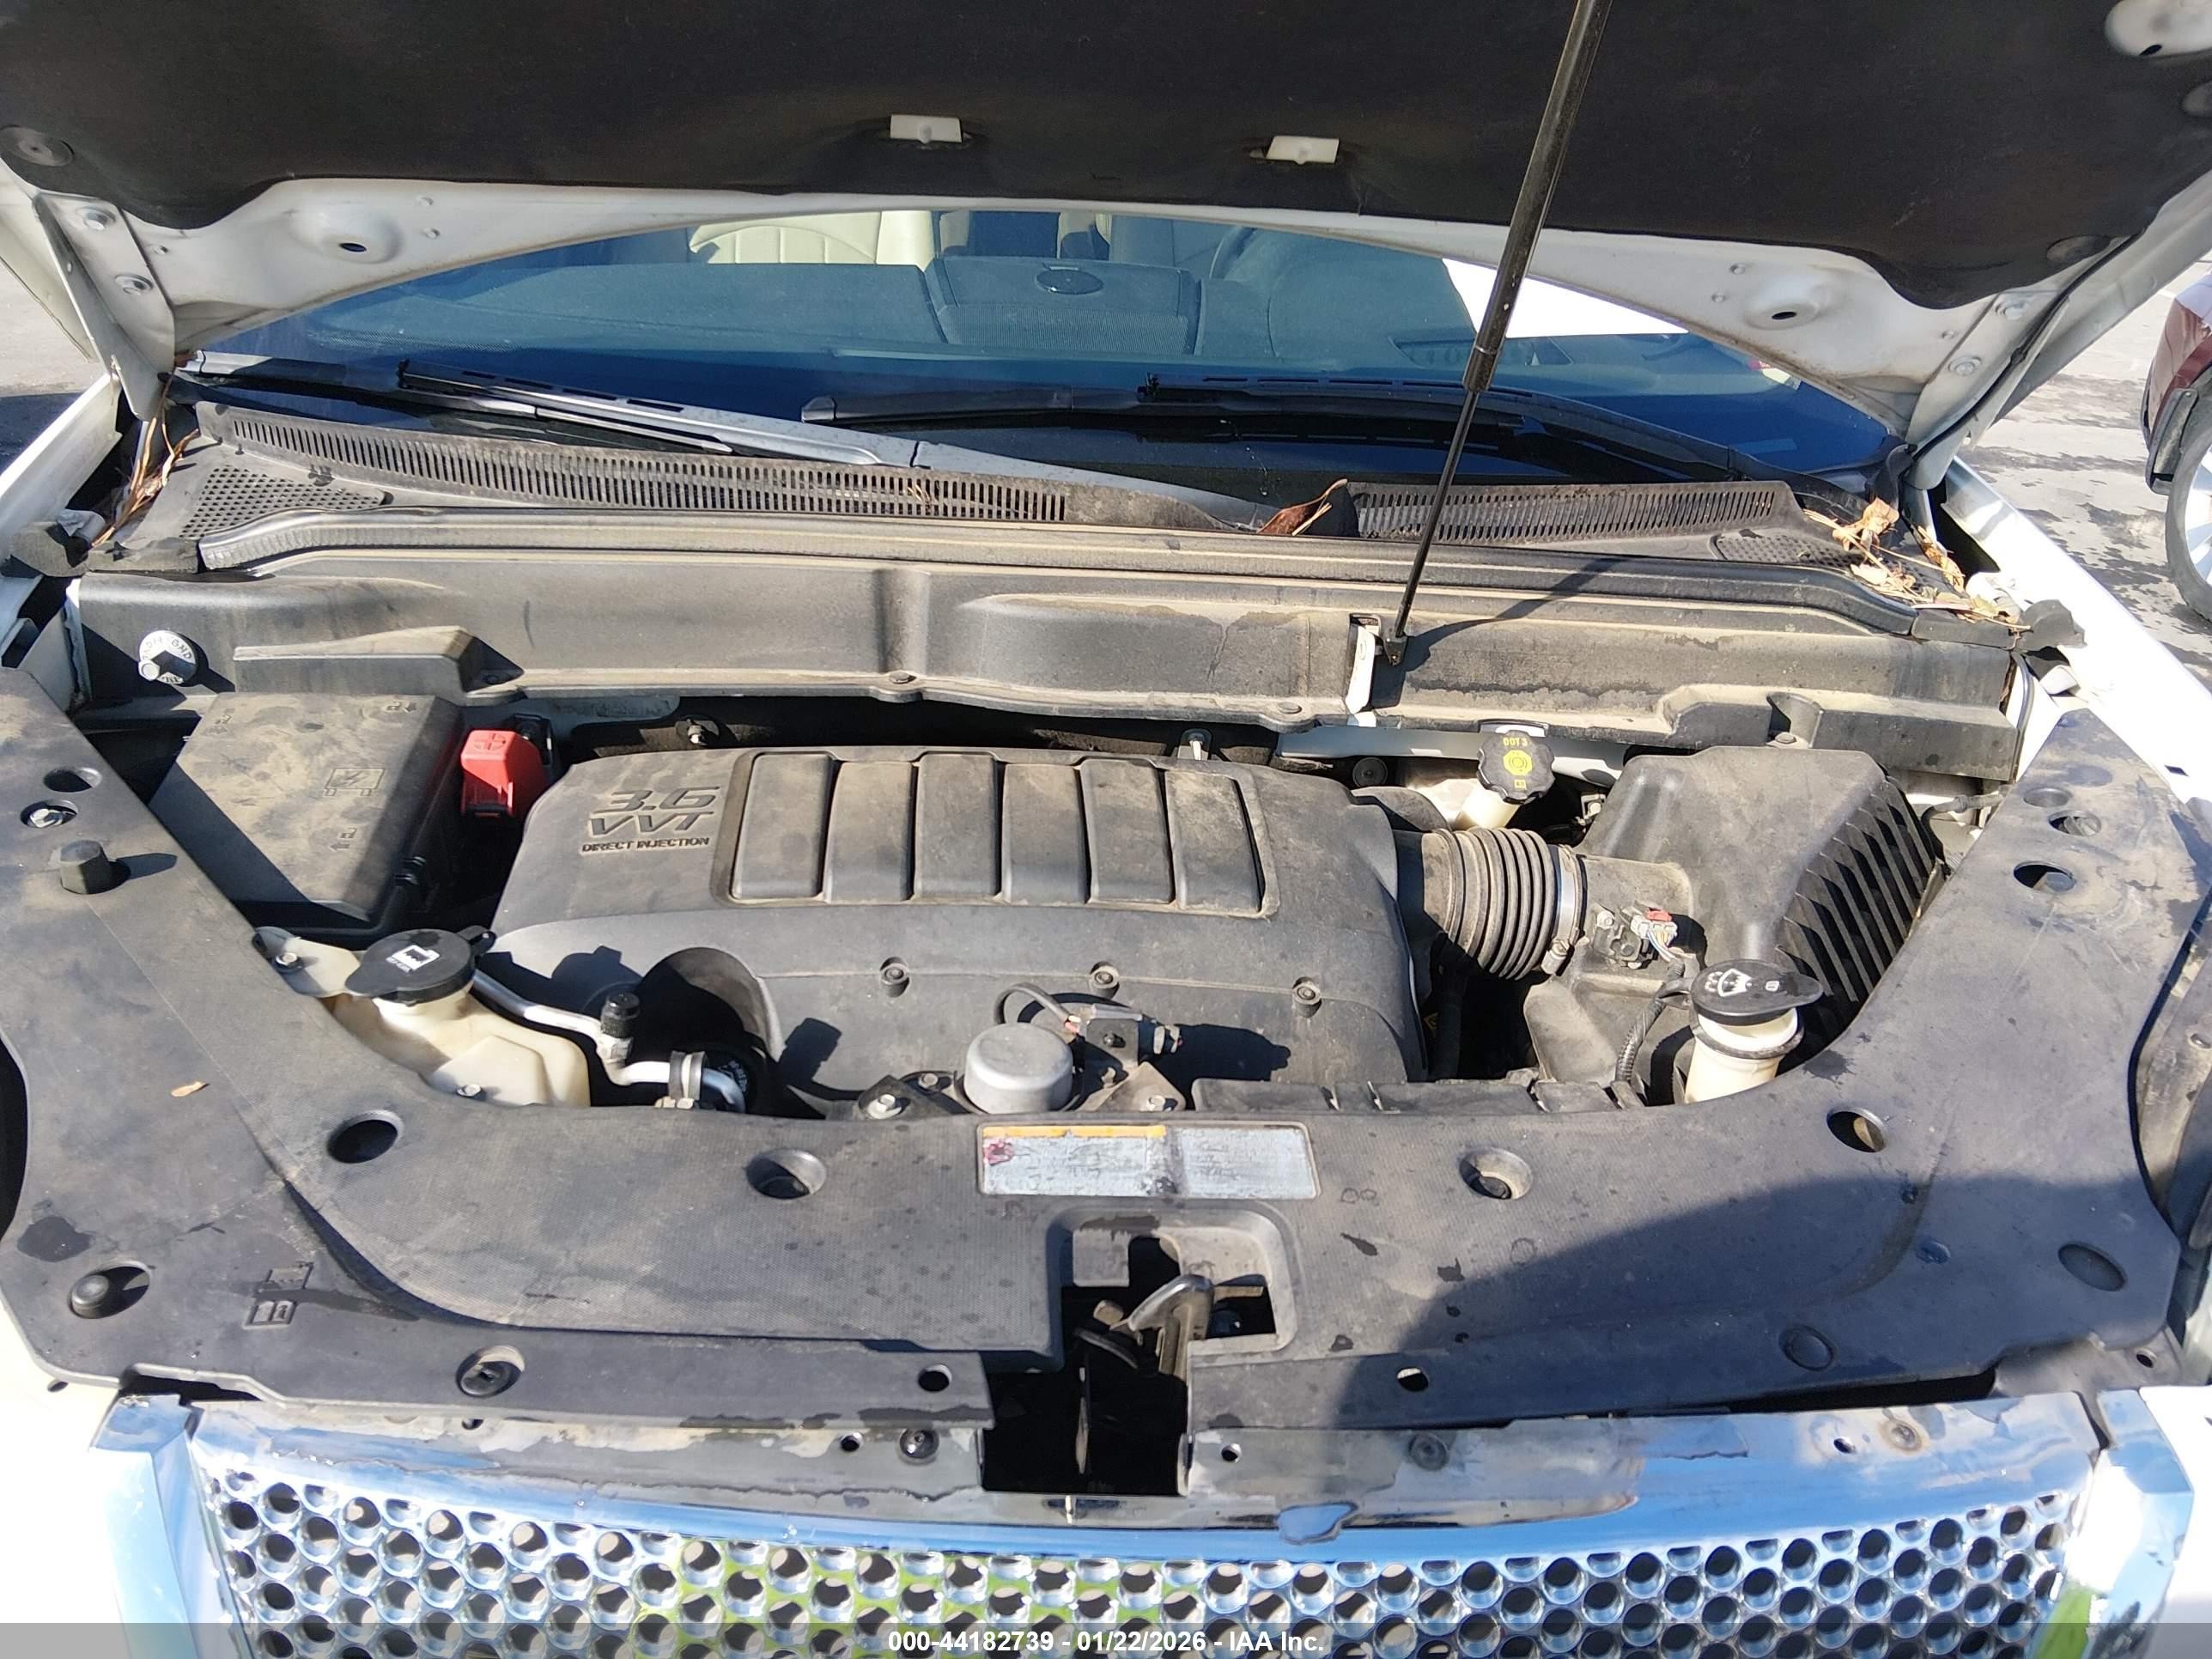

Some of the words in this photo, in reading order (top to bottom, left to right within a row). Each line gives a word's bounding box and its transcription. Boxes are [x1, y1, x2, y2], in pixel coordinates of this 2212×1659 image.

[593, 786, 720, 813] 3.6
[590, 811, 714, 836] VVT
[581, 841, 635, 852] DIRECT
[637, 837, 709, 849] INJECTION
